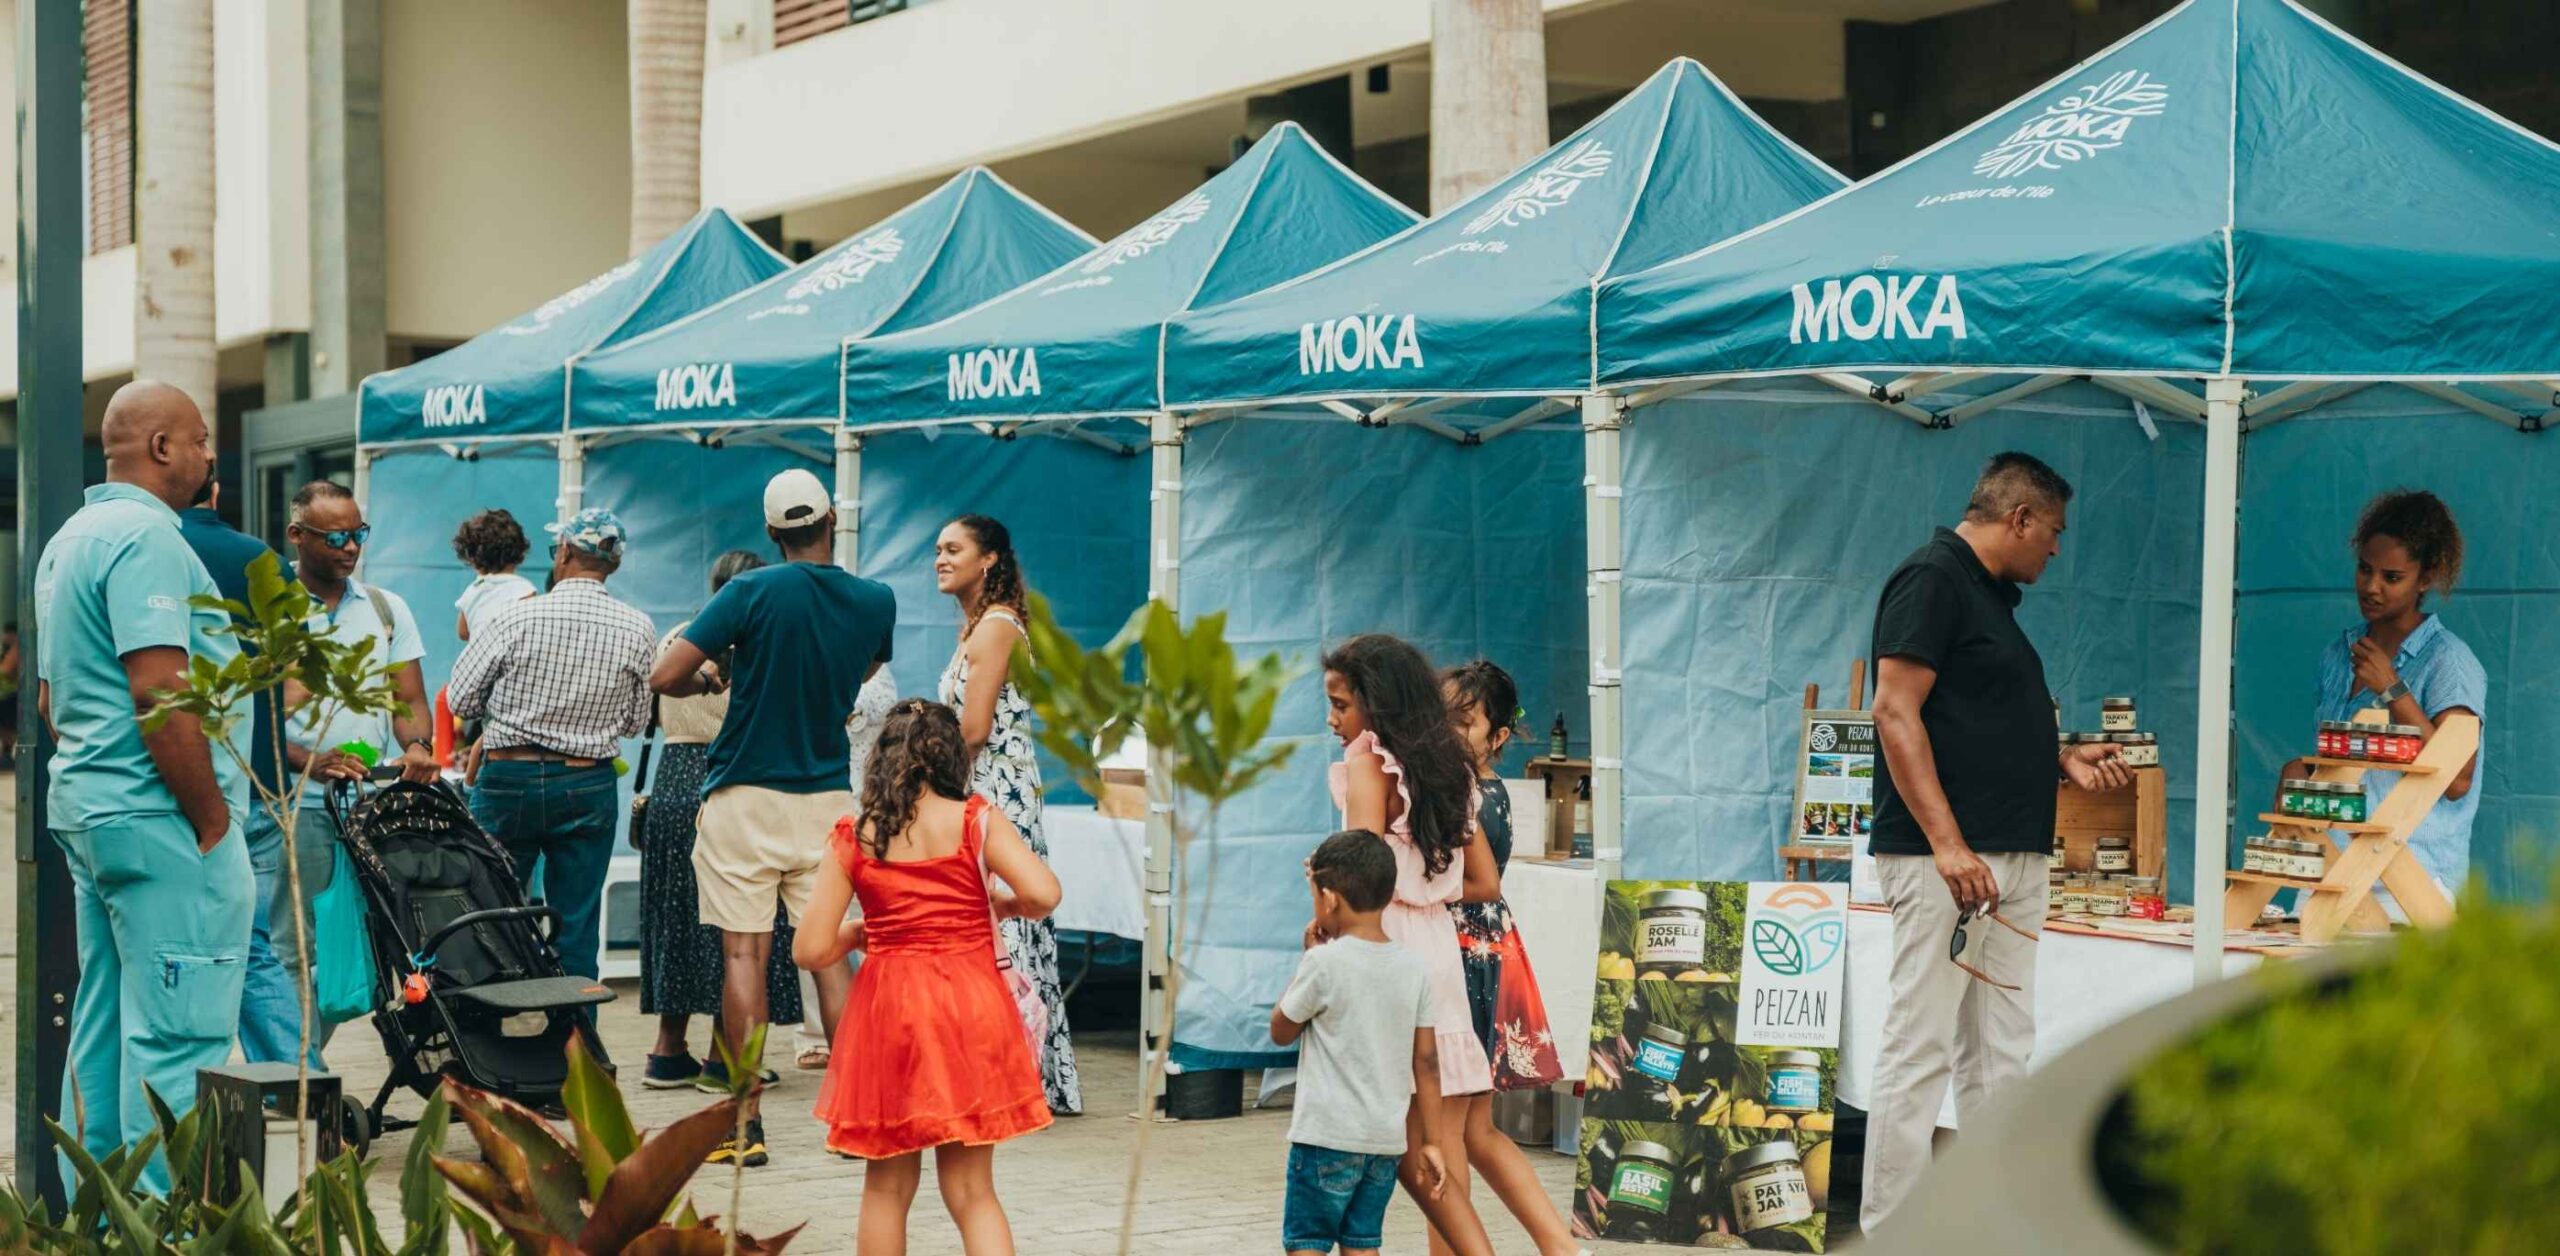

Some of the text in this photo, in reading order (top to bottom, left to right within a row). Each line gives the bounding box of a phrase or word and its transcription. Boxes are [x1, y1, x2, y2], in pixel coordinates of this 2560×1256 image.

[1998, 113, 2133, 147] MOKA
[1990, 185, 2016, 197] de
[1790, 274, 1967, 344] MOKA
[1300, 313, 1424, 375] MOKA
[655, 362, 736, 411] MOKA
[948, 347, 1041, 401] MOKA
[422, 384, 486, 427] MOKA
[1848, 725, 1874, 741] PEIZAN
[1648, 937, 1676, 948] JAM
[1649, 926, 1700, 937] ROSELLE
[1754, 988, 1827, 1027] PEIZAN
[1621, 1171, 1662, 1192] BASIL
